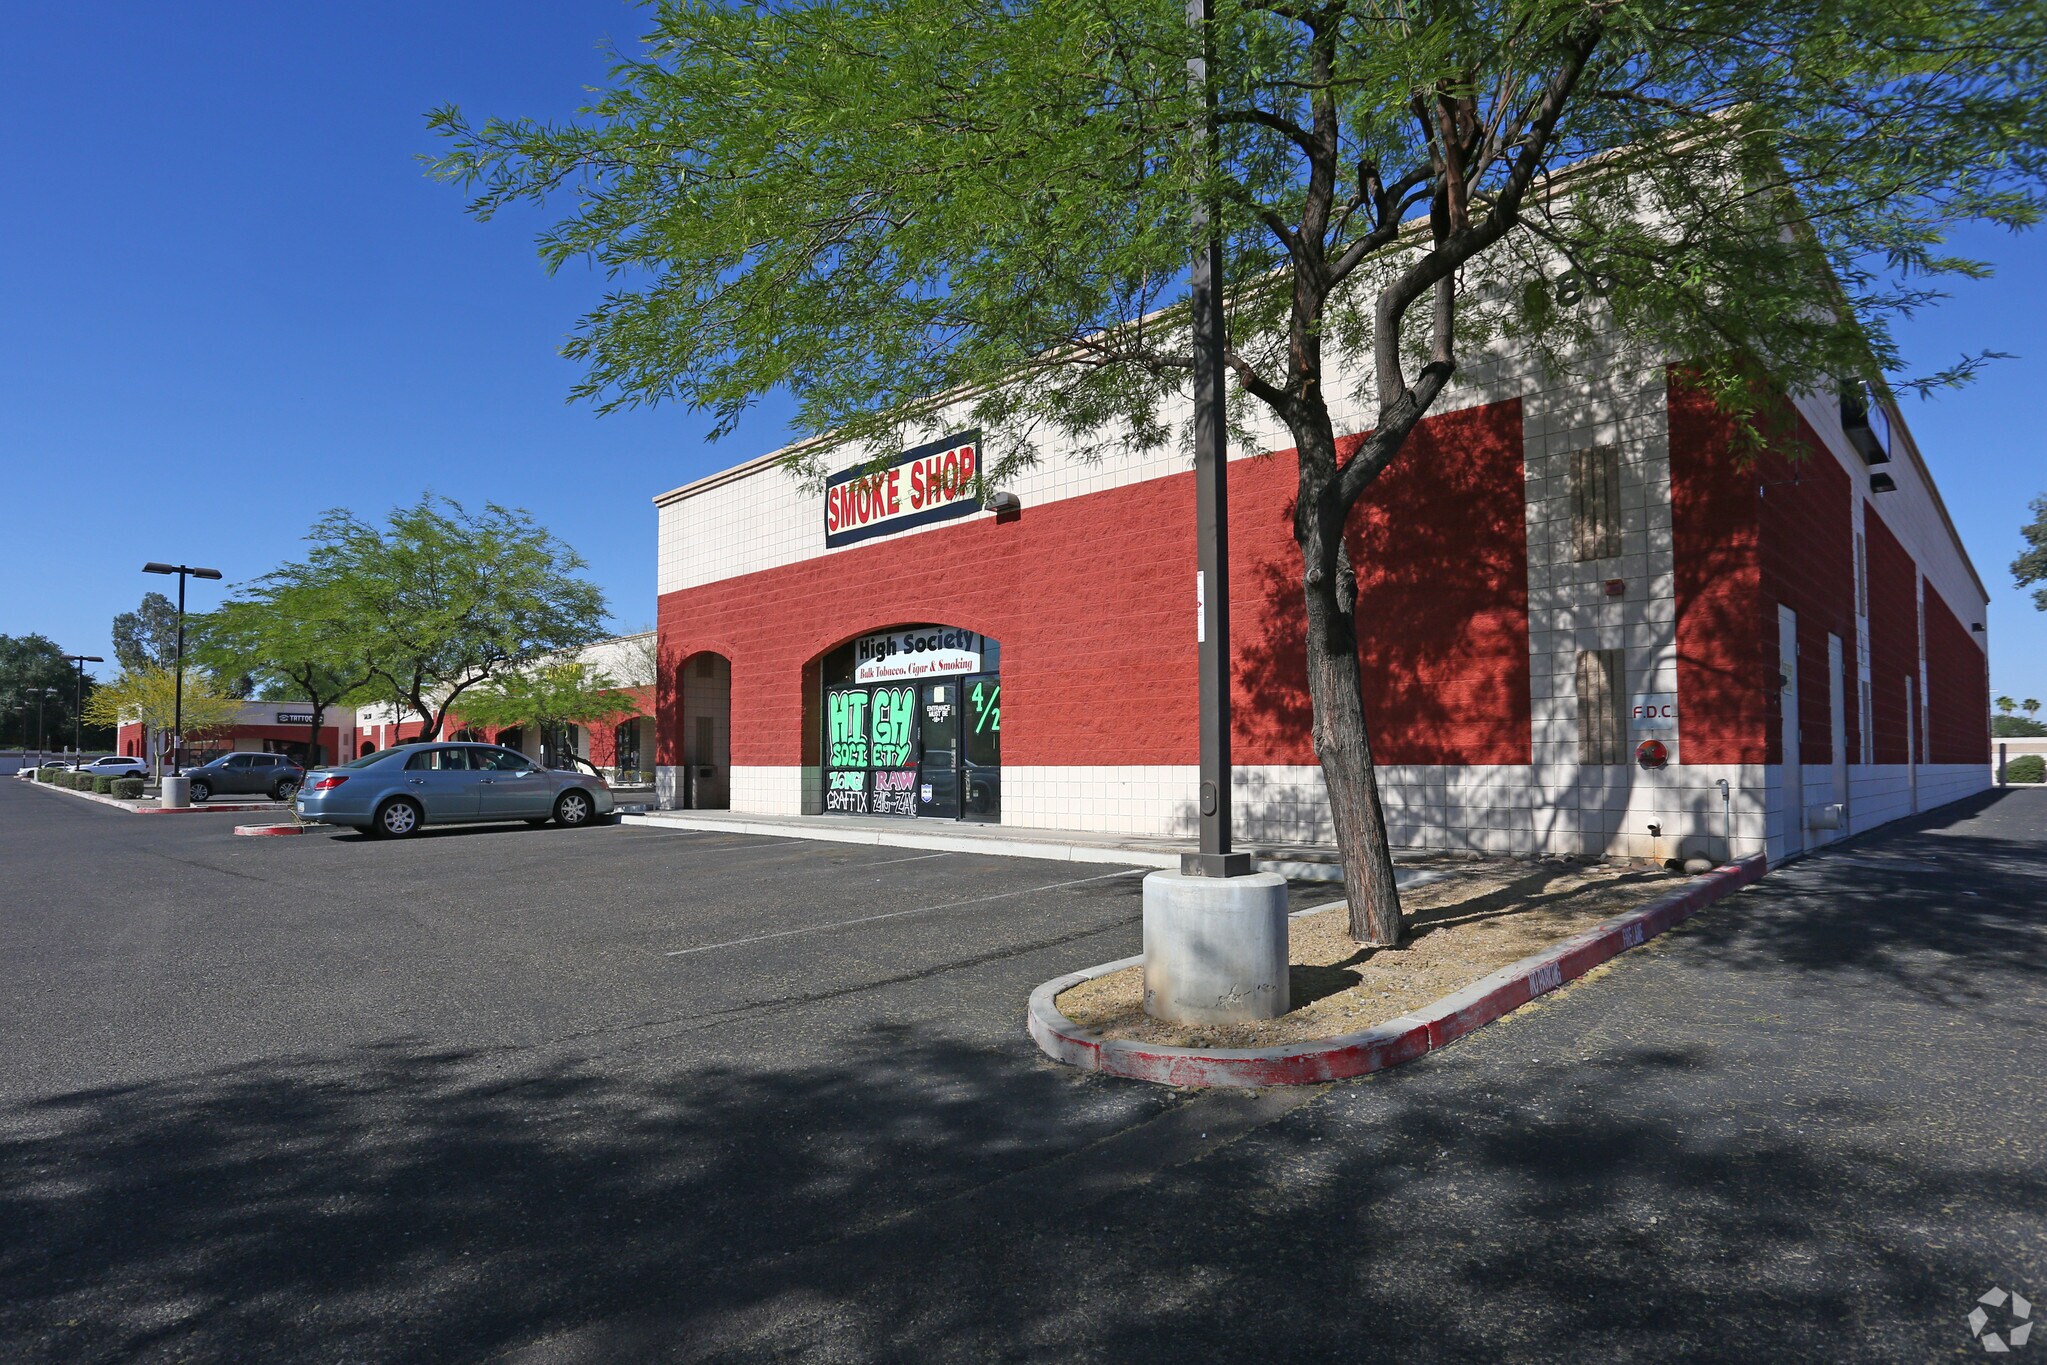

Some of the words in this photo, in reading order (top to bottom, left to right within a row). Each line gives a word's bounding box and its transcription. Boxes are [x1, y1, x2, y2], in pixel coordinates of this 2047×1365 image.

[829, 470, 900, 531] SMOKE
[911, 447, 974, 509] SHOP
[860, 636, 897, 662] High
[904, 628, 974, 655] Society
[860, 668, 875, 679] Bulk
[908, 662, 928, 676] Cigar
[929, 662, 936, 672] &
[938, 657, 973, 671] Smoking
[926, 704, 951, 712] ENTRANCE
[875, 770, 917, 791] RAW
[826, 790, 868, 814] GRAFFIX
